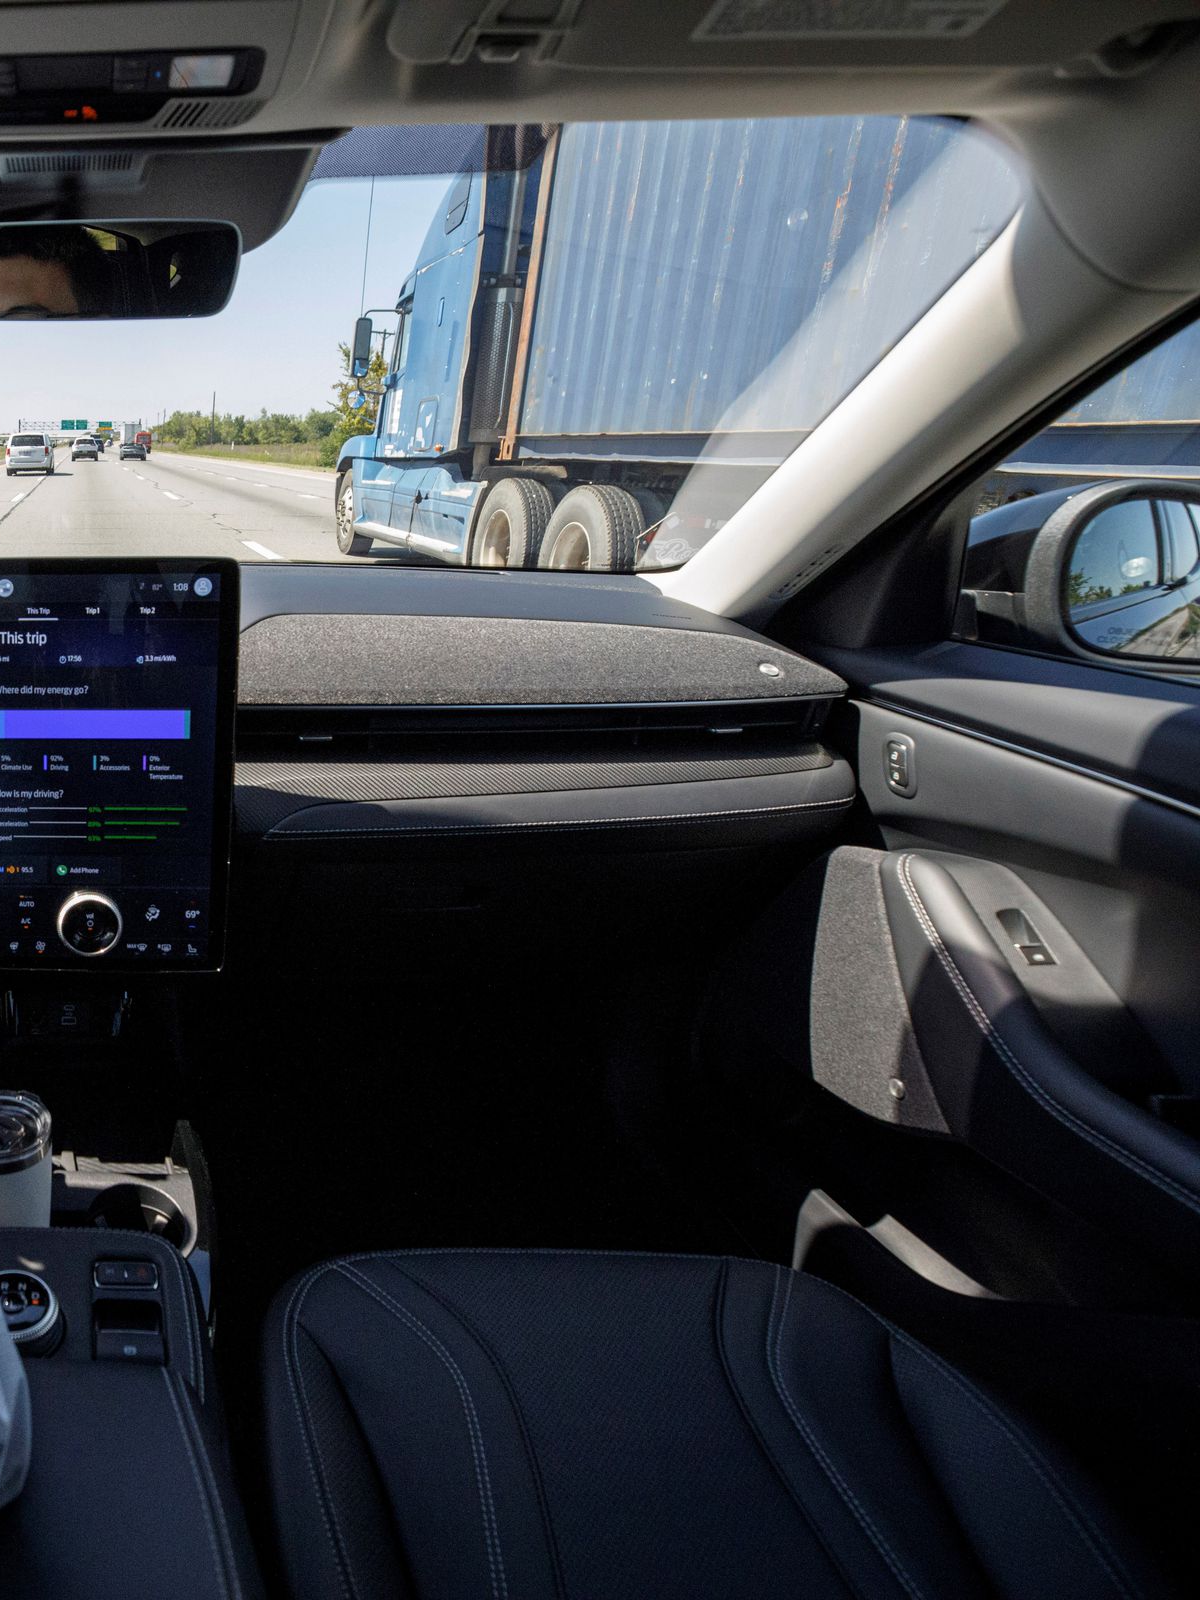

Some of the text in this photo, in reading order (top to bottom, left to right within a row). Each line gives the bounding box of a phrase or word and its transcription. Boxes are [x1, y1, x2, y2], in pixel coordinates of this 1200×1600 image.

[173, 583, 189, 592] 1:08
[39, 607, 50, 615] Trip
[85, 607, 97, 615] Trip
[139, 607, 150, 615] Trip
[0, 631, 47, 647] This trip
[20, 685, 33, 694] did
[34, 687, 46, 696] my
[47, 687, 73, 696] energy
[73, 686, 89, 696] go?
[50, 764, 69, 772] Driving
[13, 789, 20, 798] is
[20, 791, 32, 799] my
[33, 789, 64, 799] driving?
[18, 1281, 27, 1291] N
[31, 1291, 40, 1300] D
